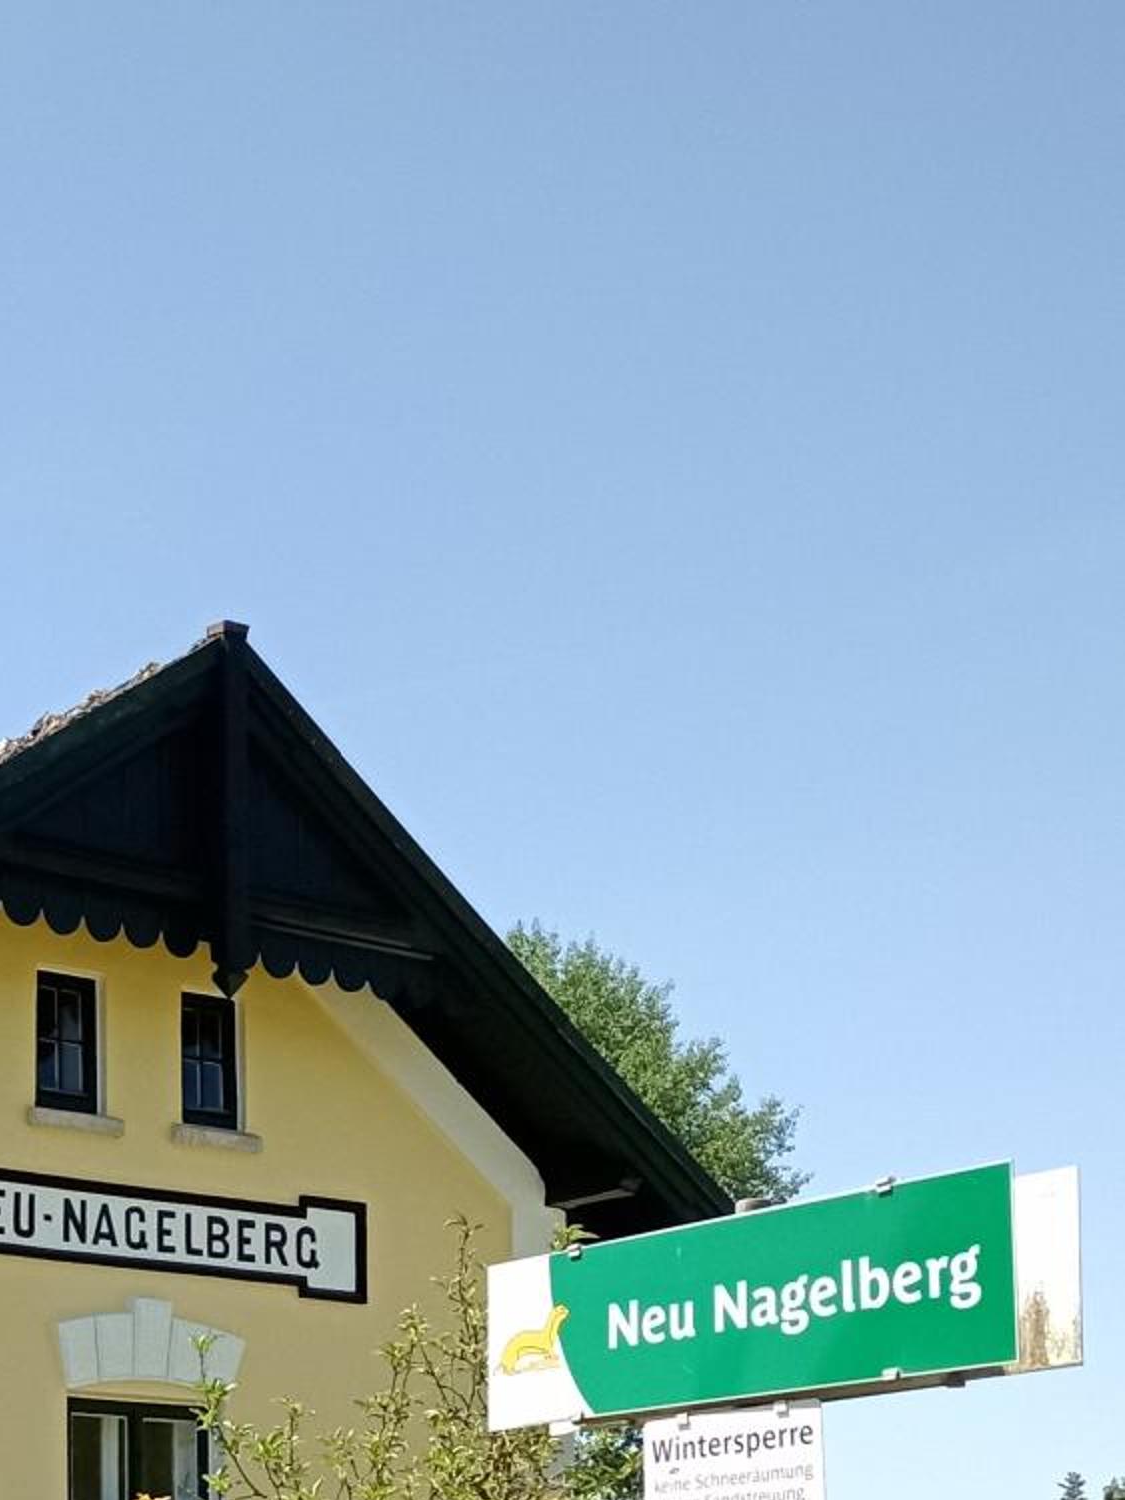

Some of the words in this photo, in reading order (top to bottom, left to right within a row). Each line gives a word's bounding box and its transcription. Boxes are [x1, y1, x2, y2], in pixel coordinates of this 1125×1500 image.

[607, 1299, 696, 1350] Neu
[713, 1243, 983, 1335] Nagelberg
[651, 1424, 814, 1464] Wintersperre
[654, 1478, 691, 1494] keine
